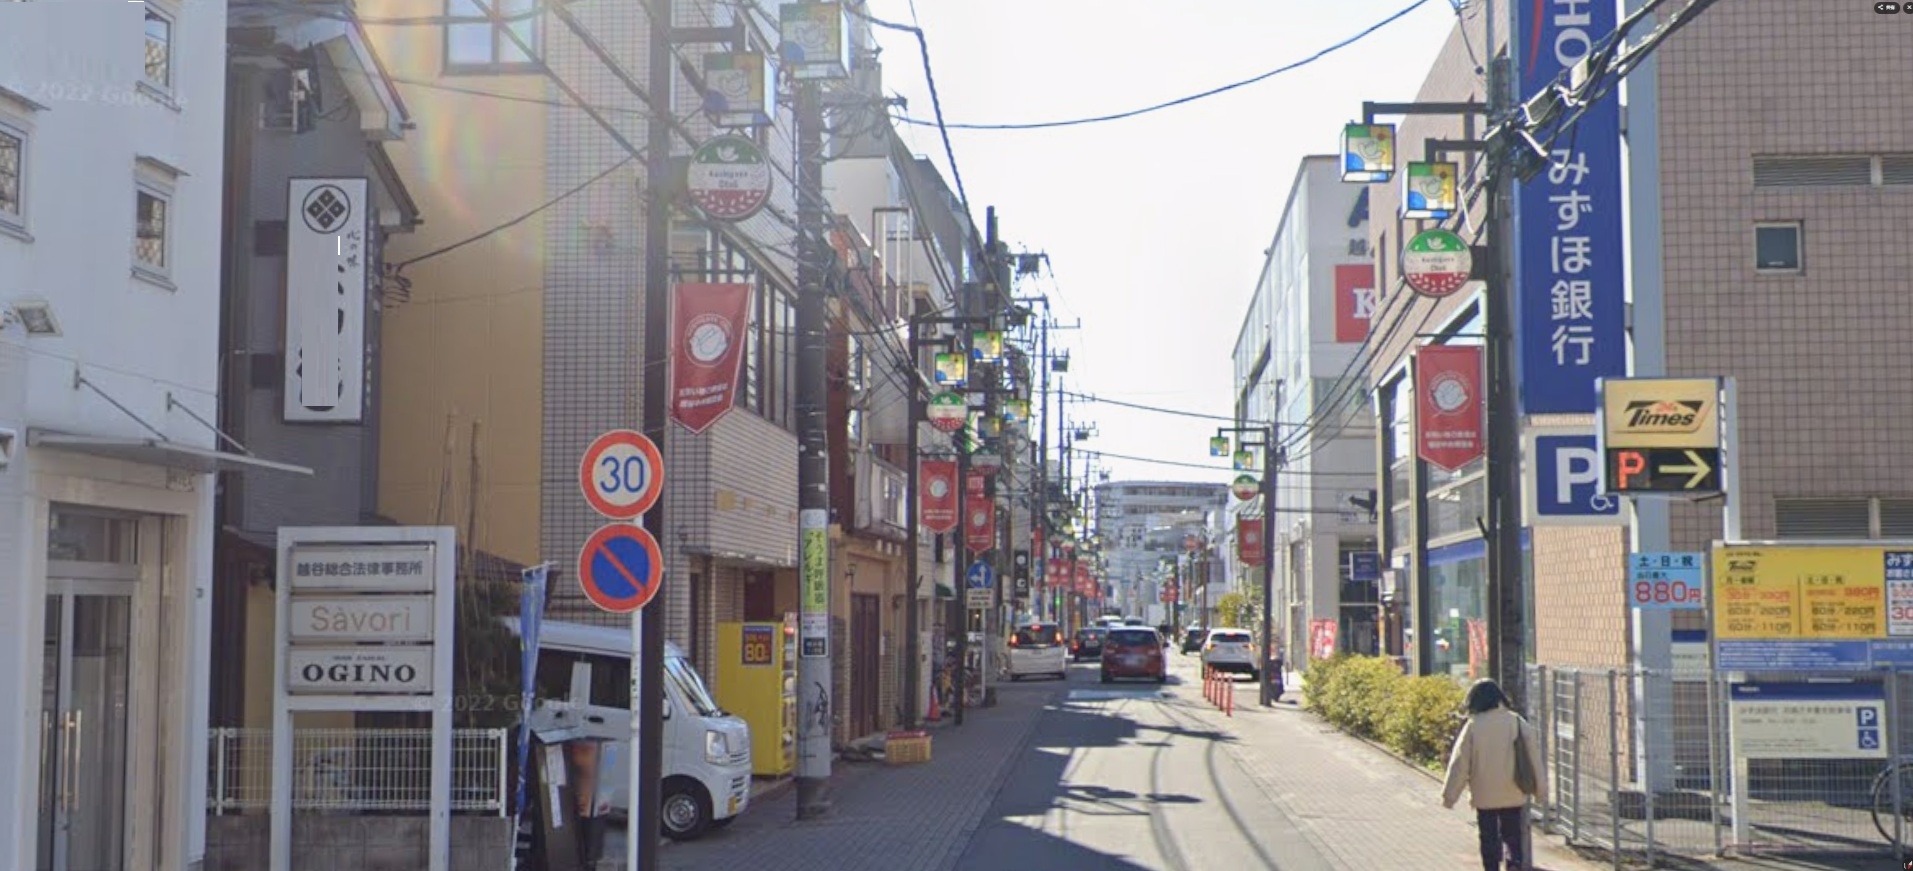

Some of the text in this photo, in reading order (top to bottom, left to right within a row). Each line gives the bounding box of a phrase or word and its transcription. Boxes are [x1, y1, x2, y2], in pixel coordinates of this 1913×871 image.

[1548, 149, 1595, 366] みずほ銀行
[1624, 400, 1703, 428] Times
[600, 455, 645, 493] 30
[1556, 447, 1599, 504] P
[1616, 450, 1646, 489] P
[296, 560, 424, 577] 越谷総合法律事務所
[1639, 555, 1694, 567] 土・日・祝
[1635, 581, 1702, 603] 880円
[310, 605, 411, 632] Sàvori
[302, 663, 417, 683] OGINO
[1860, 709, 1875, 725] P
